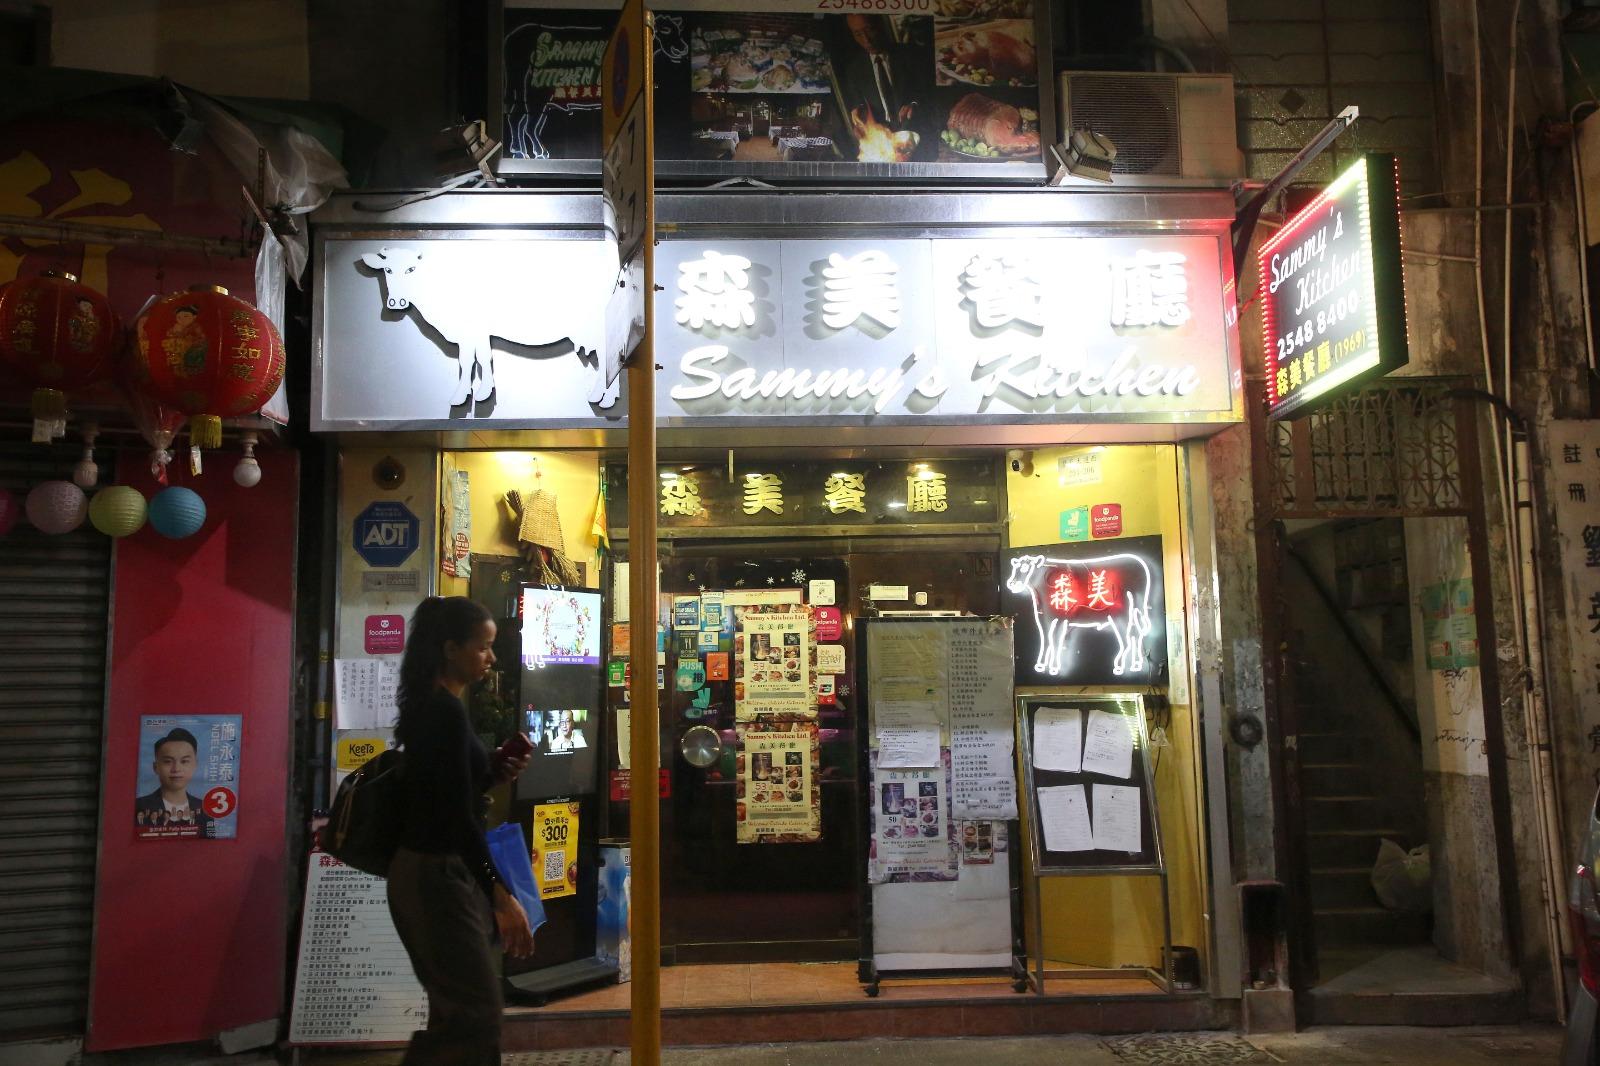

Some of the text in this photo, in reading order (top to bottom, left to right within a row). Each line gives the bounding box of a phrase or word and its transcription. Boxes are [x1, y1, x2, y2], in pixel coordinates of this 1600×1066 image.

[1269, 206, 1344, 294] Sammy's
[675, 249, 1190, 330] 森美餐廳
[1295, 248, 1361, 316] Kitchen
[1276, 287, 1360, 361] 2548 8400
[671, 342, 1200, 414] Sammy's Kitchen
[1276, 340, 1332, 396] 森美餐廳
[660, 472, 947, 516] 森美餐廳
[363, 522, 410, 546] ADT
[1050, 570, 1114, 610] 森美
[349, 743, 375, 757] KeeTa
[211, 791, 229, 814] 3
[541, 824, 569, 842] $300
[319, 855, 347, 868] 森美
